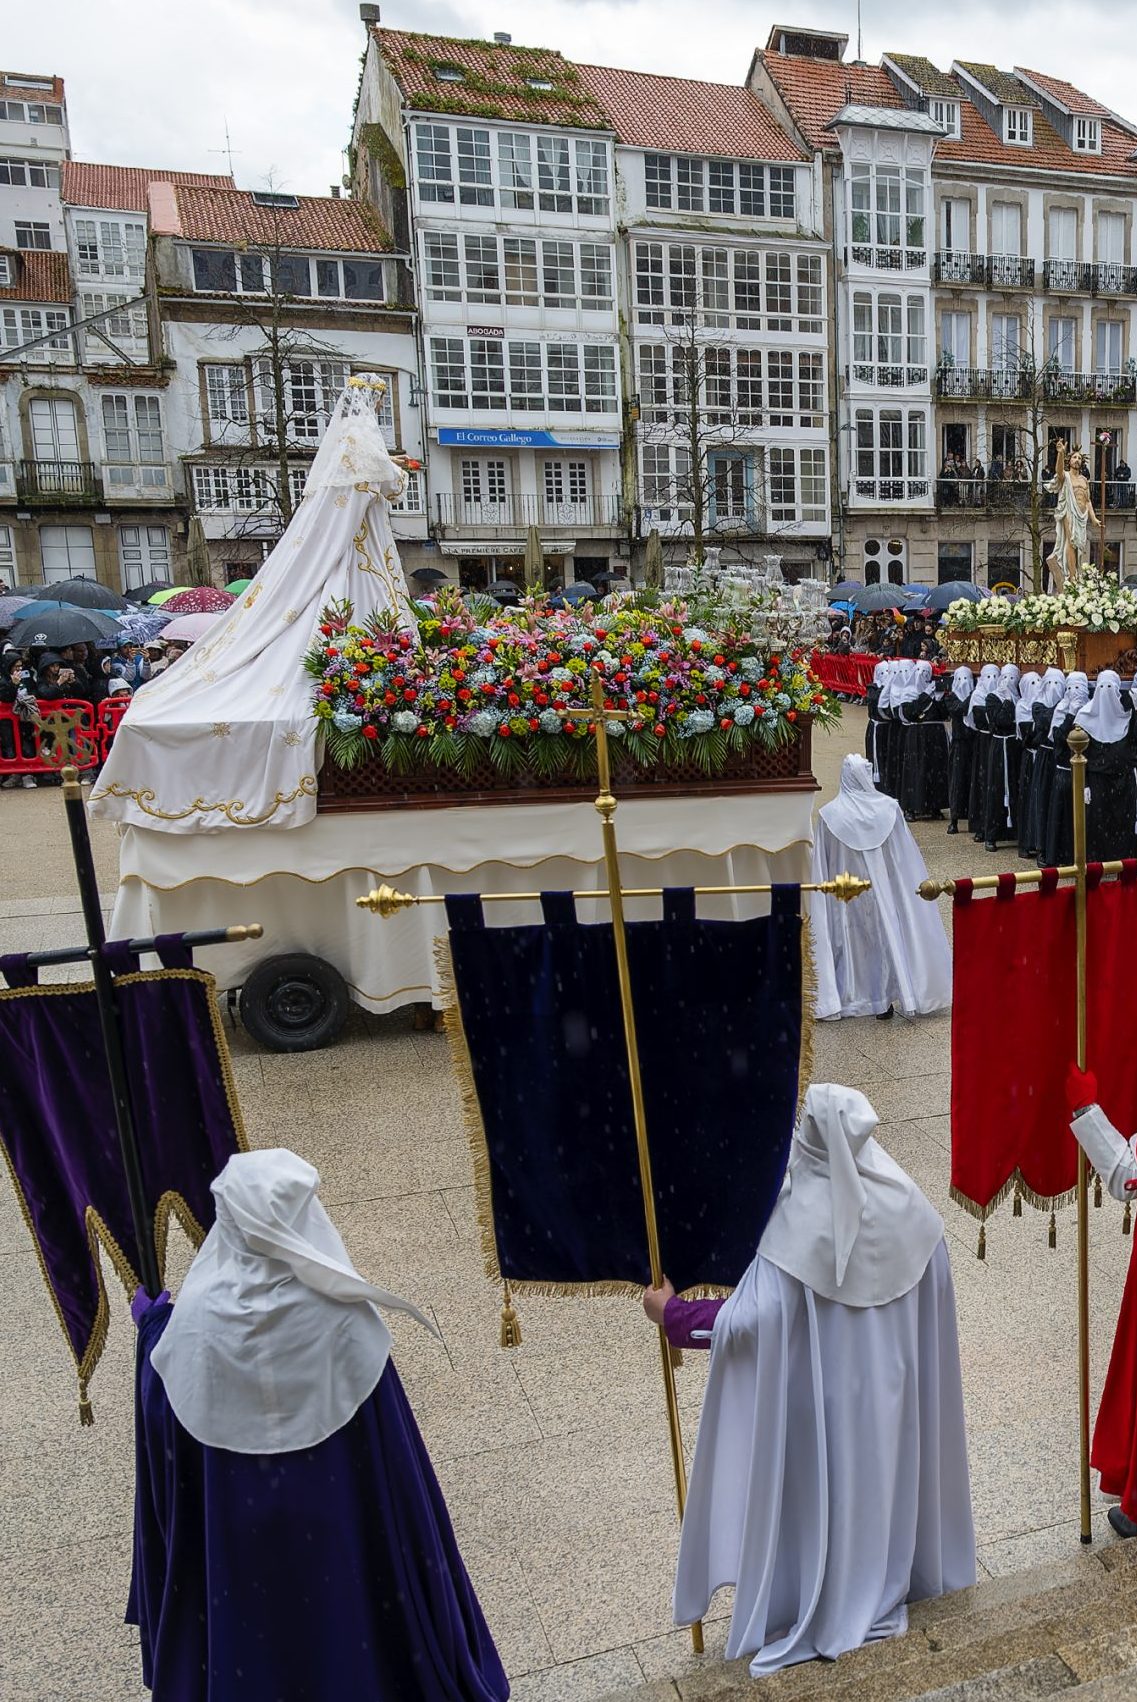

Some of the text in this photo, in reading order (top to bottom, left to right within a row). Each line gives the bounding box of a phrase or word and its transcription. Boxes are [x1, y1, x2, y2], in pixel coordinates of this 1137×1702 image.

[468, 328, 504, 336] ABOGADA
[456, 432, 532, 445] El Correo Gallego
